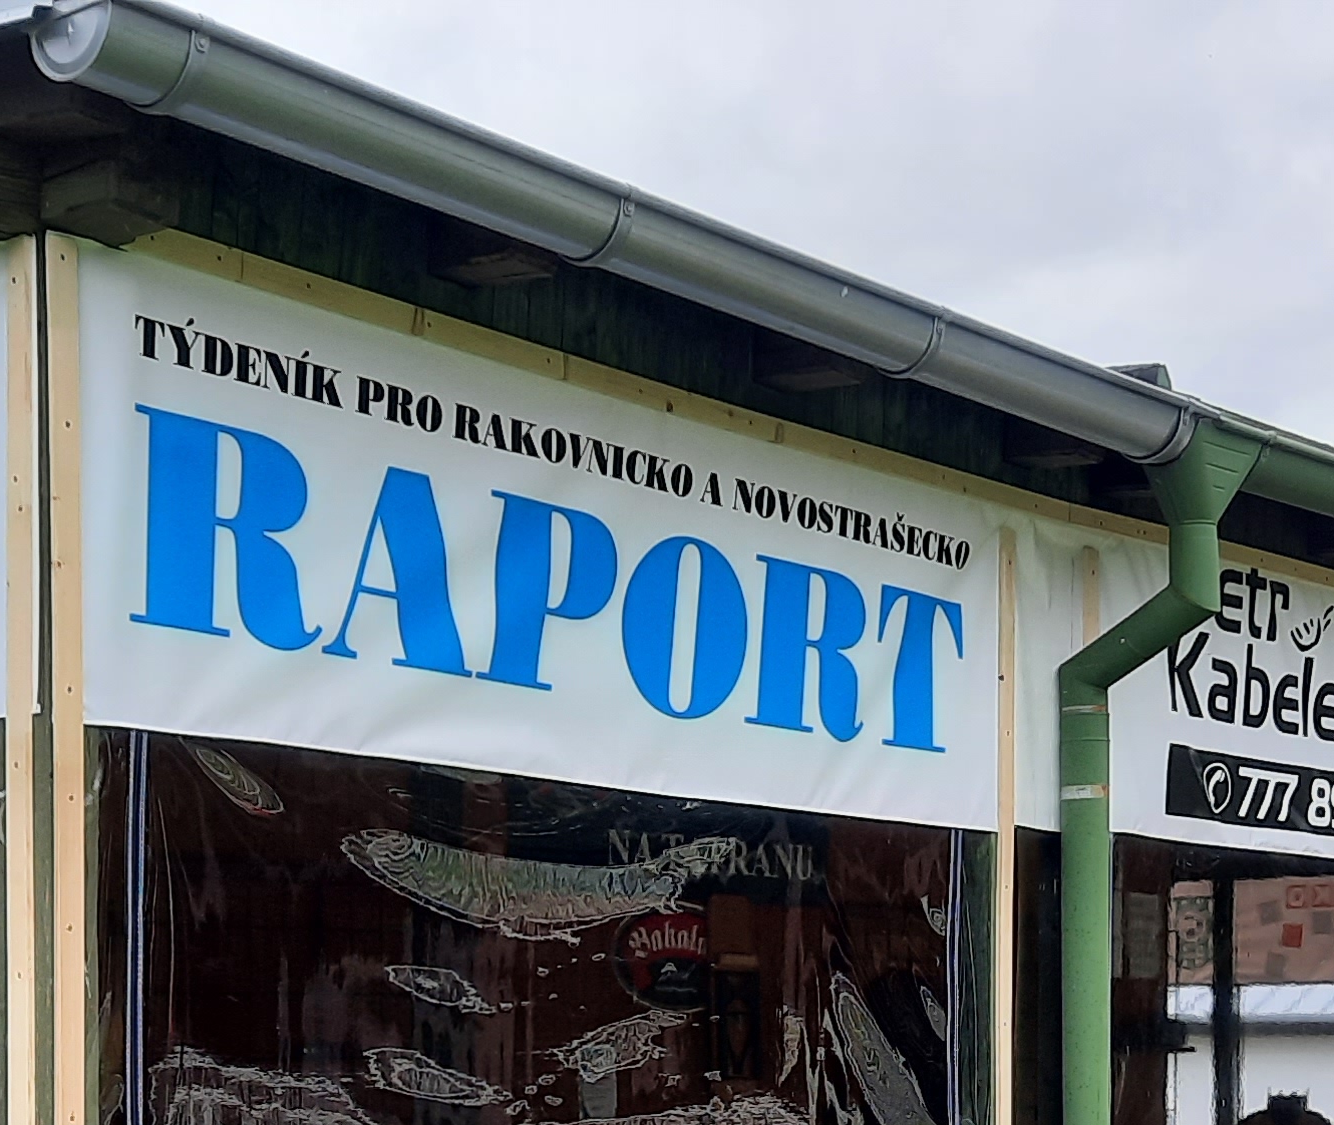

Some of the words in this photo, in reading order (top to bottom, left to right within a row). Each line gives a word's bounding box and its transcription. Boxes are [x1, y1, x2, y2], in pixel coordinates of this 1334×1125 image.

[133, 314, 343, 409] TÝDENÍK
[356, 375, 443, 434] PRO
[454, 404, 694, 499] RAKOVNICKO
[700, 472, 723, 508] A
[732, 476, 972, 571] NOVOSTRAŠECKO
[129, 402, 964, 754] RAPORT
[1215, 568, 1290, 642] etr
[1237, 766, 1299, 822] 777
